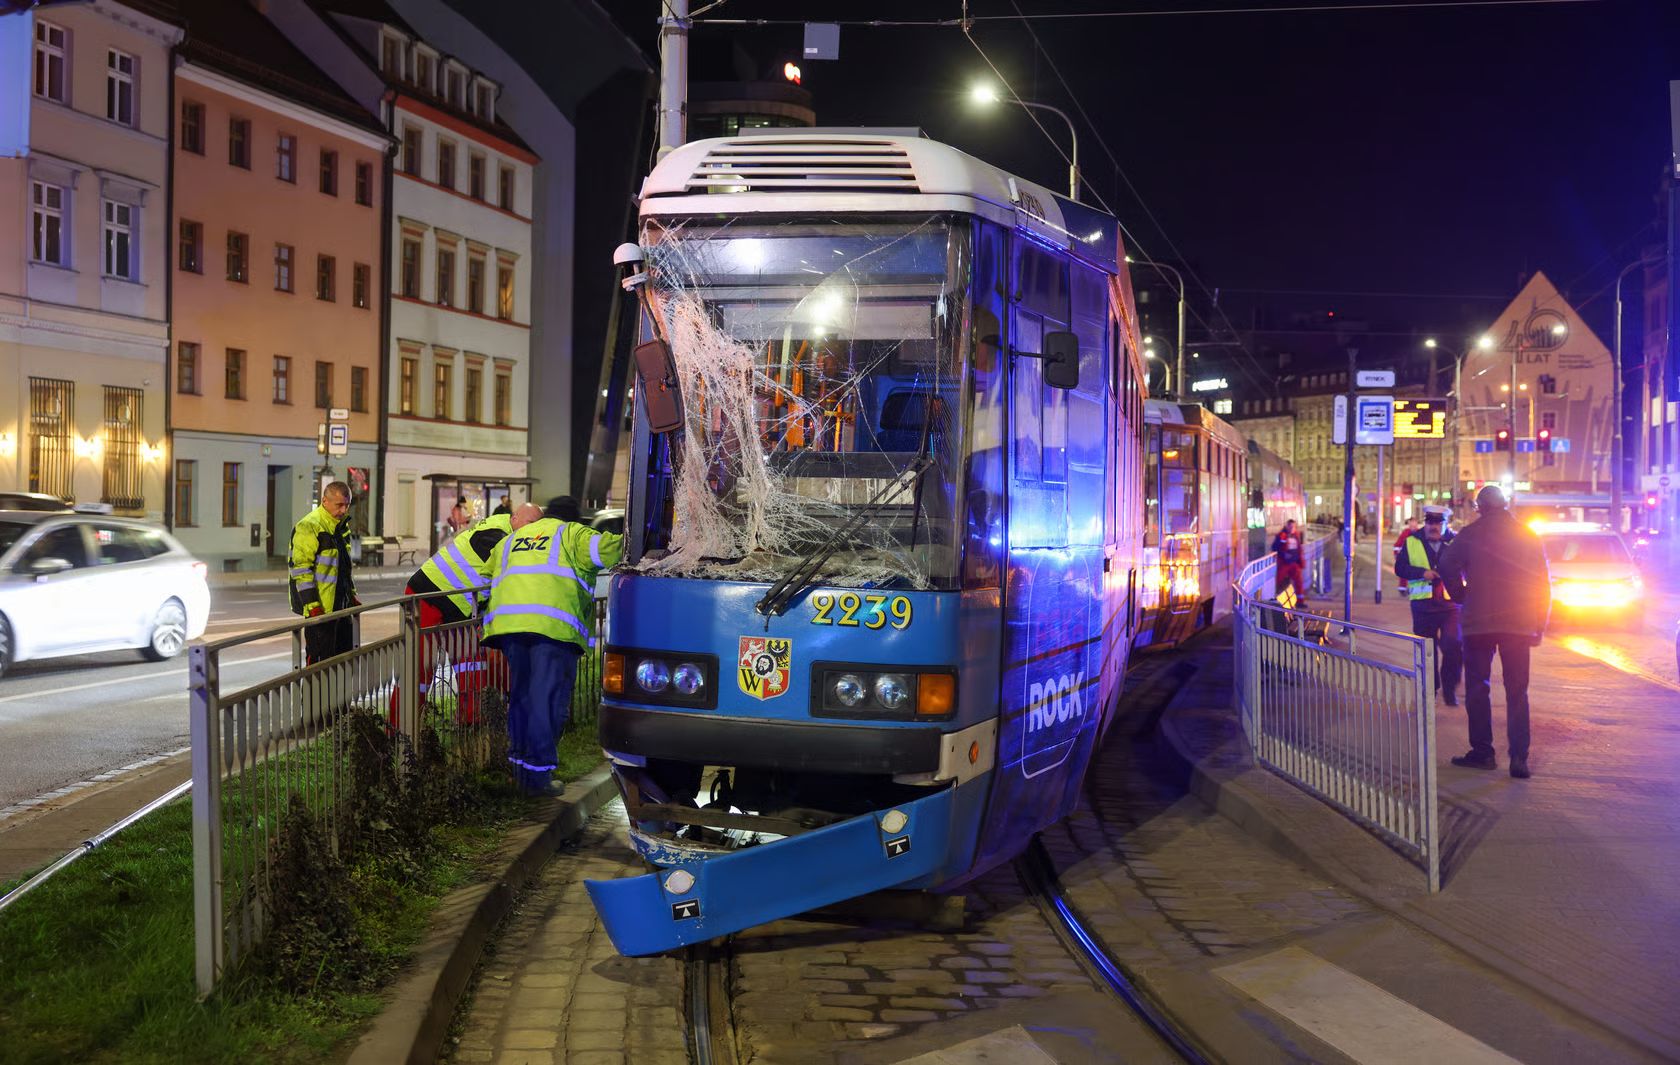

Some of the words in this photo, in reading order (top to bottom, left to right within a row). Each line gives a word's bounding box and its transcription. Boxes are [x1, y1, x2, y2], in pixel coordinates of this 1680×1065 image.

[1526, 353, 1552, 364] LAT
[811, 592, 913, 630] 2239
[740, 668, 762, 692] W
[1028, 671, 1084, 733] ROCK
